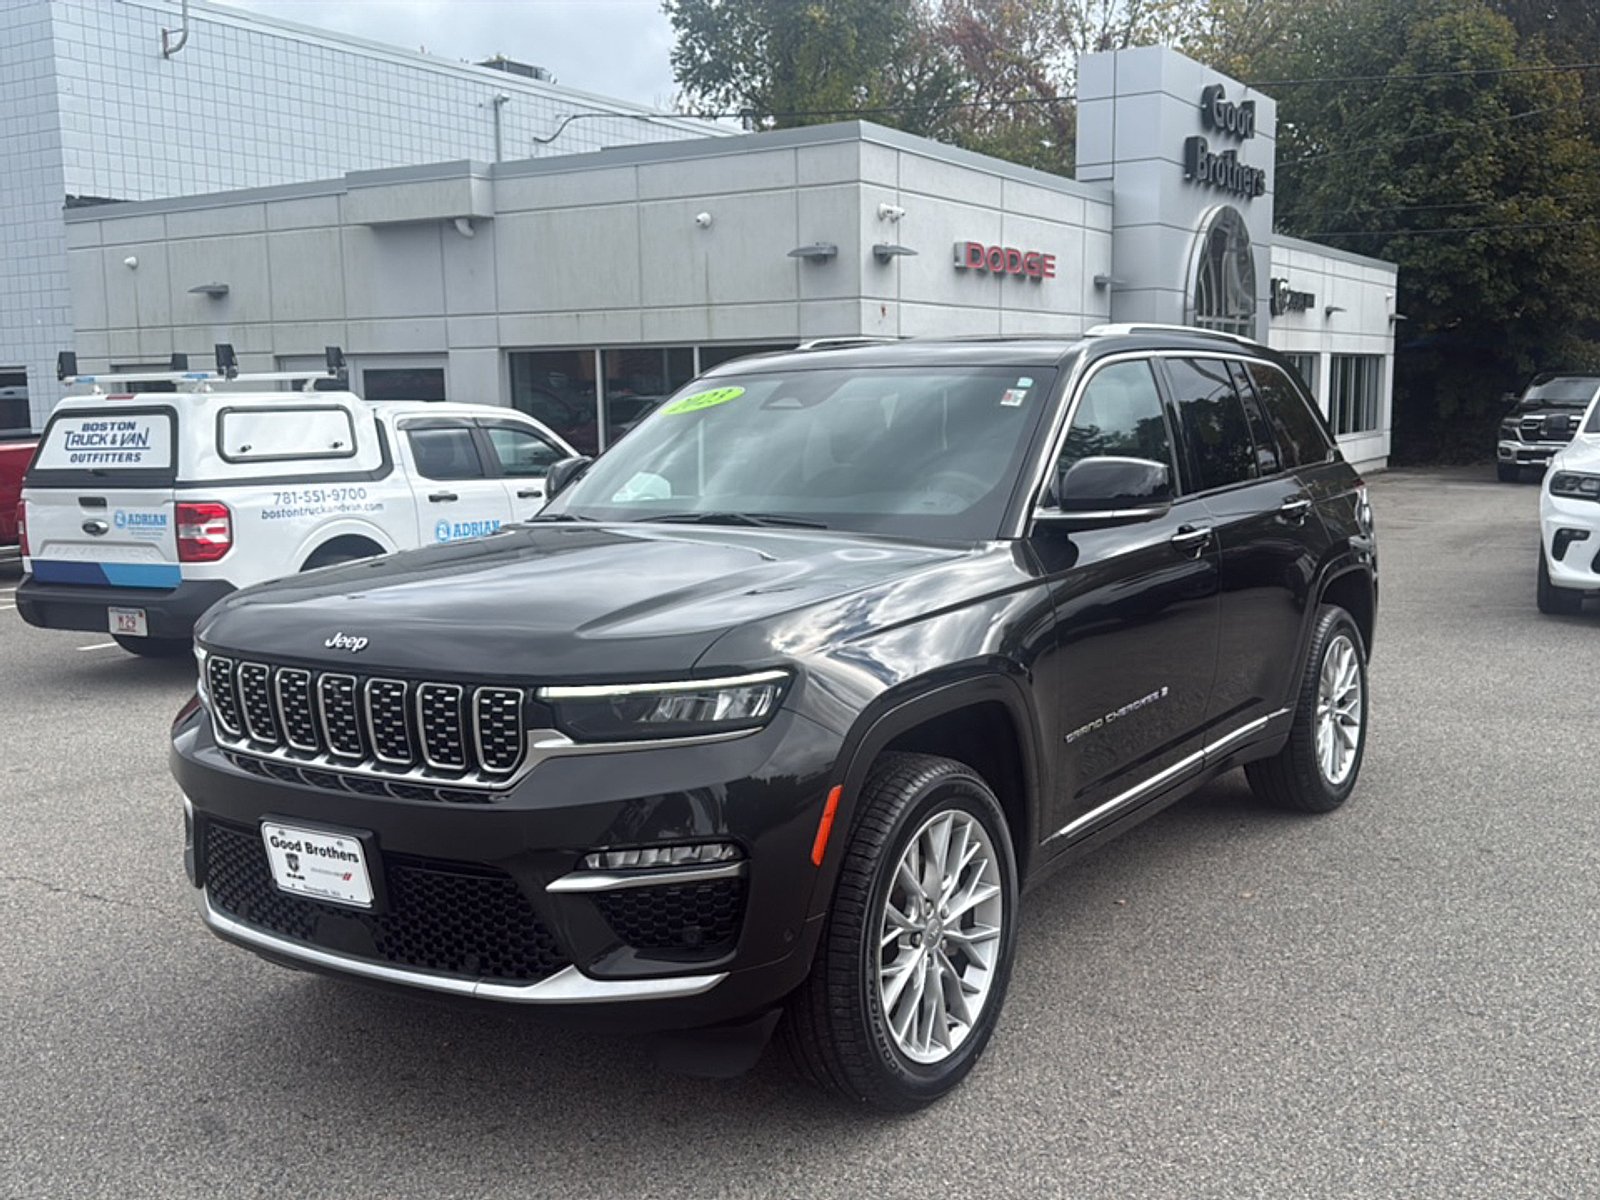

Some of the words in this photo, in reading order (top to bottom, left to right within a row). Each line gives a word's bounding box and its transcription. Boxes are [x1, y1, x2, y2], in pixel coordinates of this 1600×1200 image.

[1201, 83, 1256, 140] Good
[1184, 136, 1266, 198] Brothers
[960, 241, 1056, 278] DODGE
[82, 421, 137, 432] BOSTON
[64, 430, 108, 450] TRUCK
[109, 432, 118, 446] &
[118, 427, 150, 447] VAN
[70, 452, 142, 463] OUTFITTERS
[273, 487, 368, 505] 781-551-9700
[127, 513, 167, 526] ADRIAN
[261, 503, 385, 520] bostontruckandvan.com
[453, 519, 500, 537] ADRIAN
[325, 631, 369, 652] Jeep
[1065, 718, 1104, 743] GRAND
[270, 835, 303, 853] Good
[304, 841, 360, 863] Brothers
